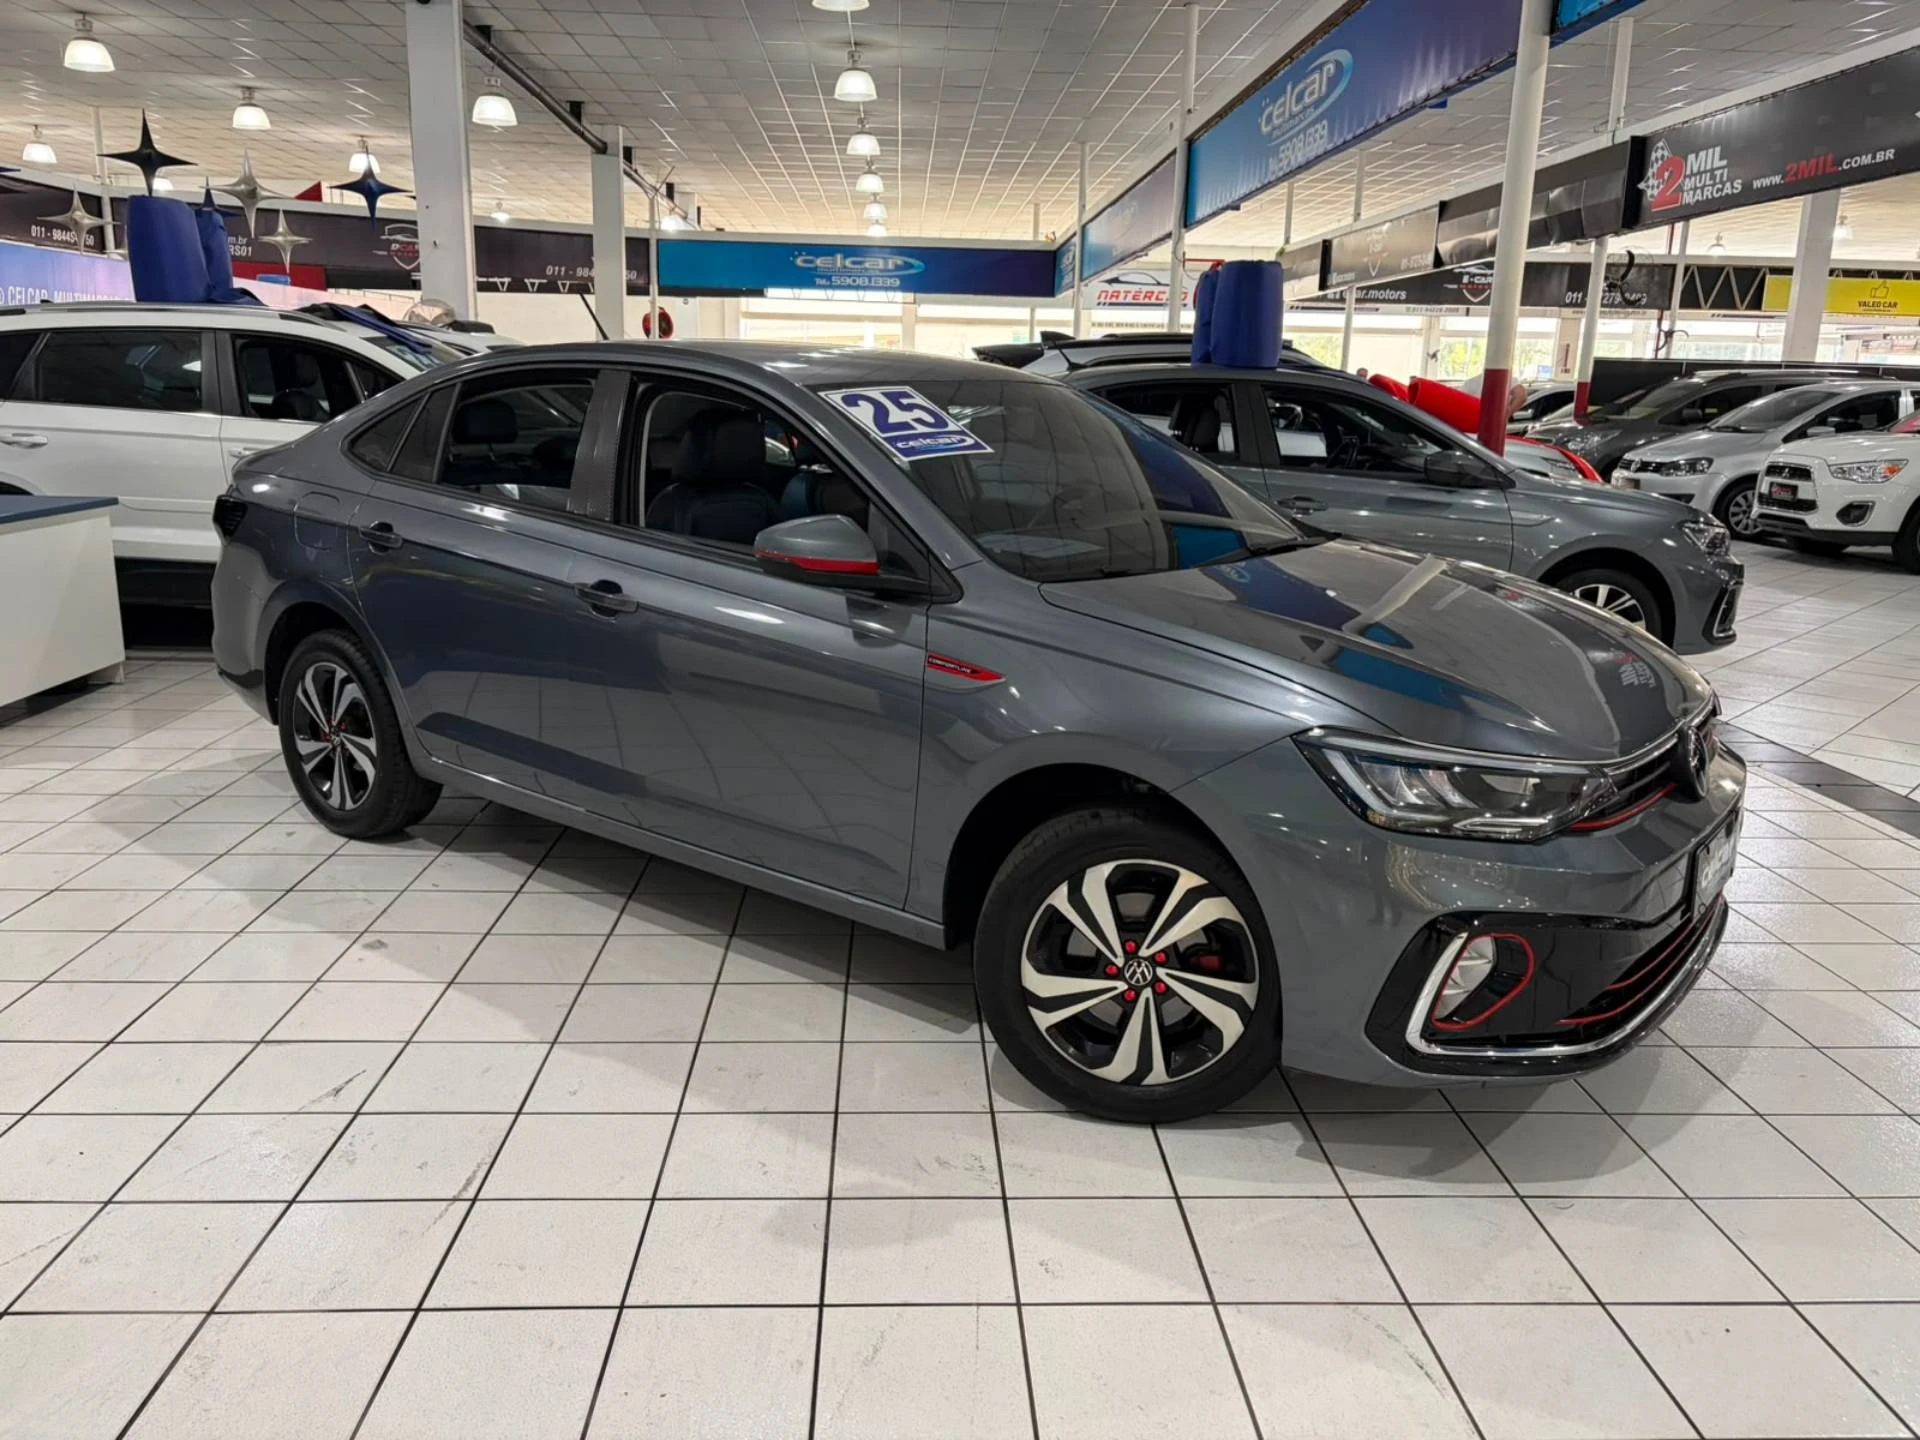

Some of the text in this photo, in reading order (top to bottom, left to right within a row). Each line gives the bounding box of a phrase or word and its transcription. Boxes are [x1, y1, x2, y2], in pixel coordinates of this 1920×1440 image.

[1261, 61, 1335, 134] celcar
[1686, 145, 1728, 176] MIL
[1752, 148, 1895, 189] www.2MIL.COM.BR
[1650, 154, 1685, 212] 2
[1681, 179, 1743, 205] MARCAS
[1684, 168, 1728, 191] MULTI
[31, 224, 46, 238] 011
[546, 265, 565, 276] 011
[796, 253, 904, 270] celcar
[1565, 291, 1583, 303] 011
[840, 391, 950, 435] 25
